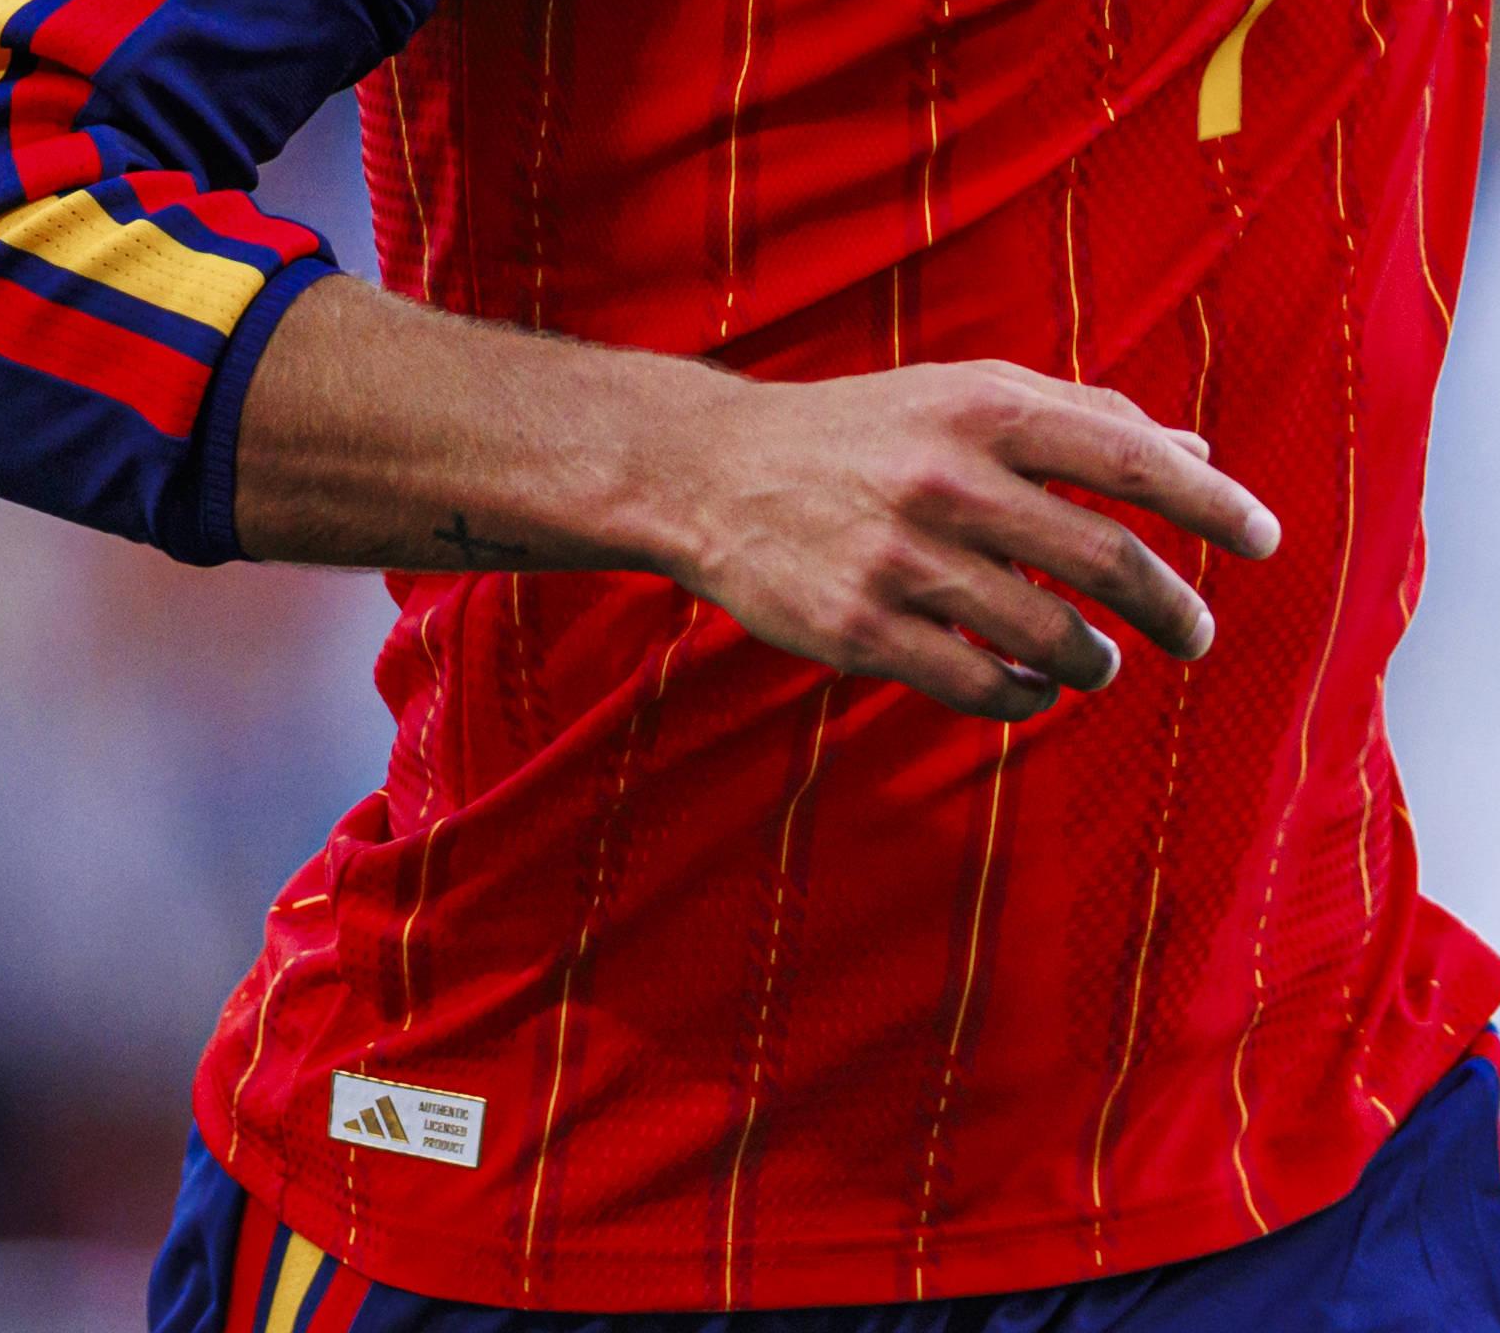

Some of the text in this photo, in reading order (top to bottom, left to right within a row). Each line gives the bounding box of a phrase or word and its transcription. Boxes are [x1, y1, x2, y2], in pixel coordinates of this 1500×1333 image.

[418, 1101, 468, 1120] AUTHENTIC
[423, 1118, 468, 1137] LICENSED
[423, 1136, 465, 1154] PRODUCT
